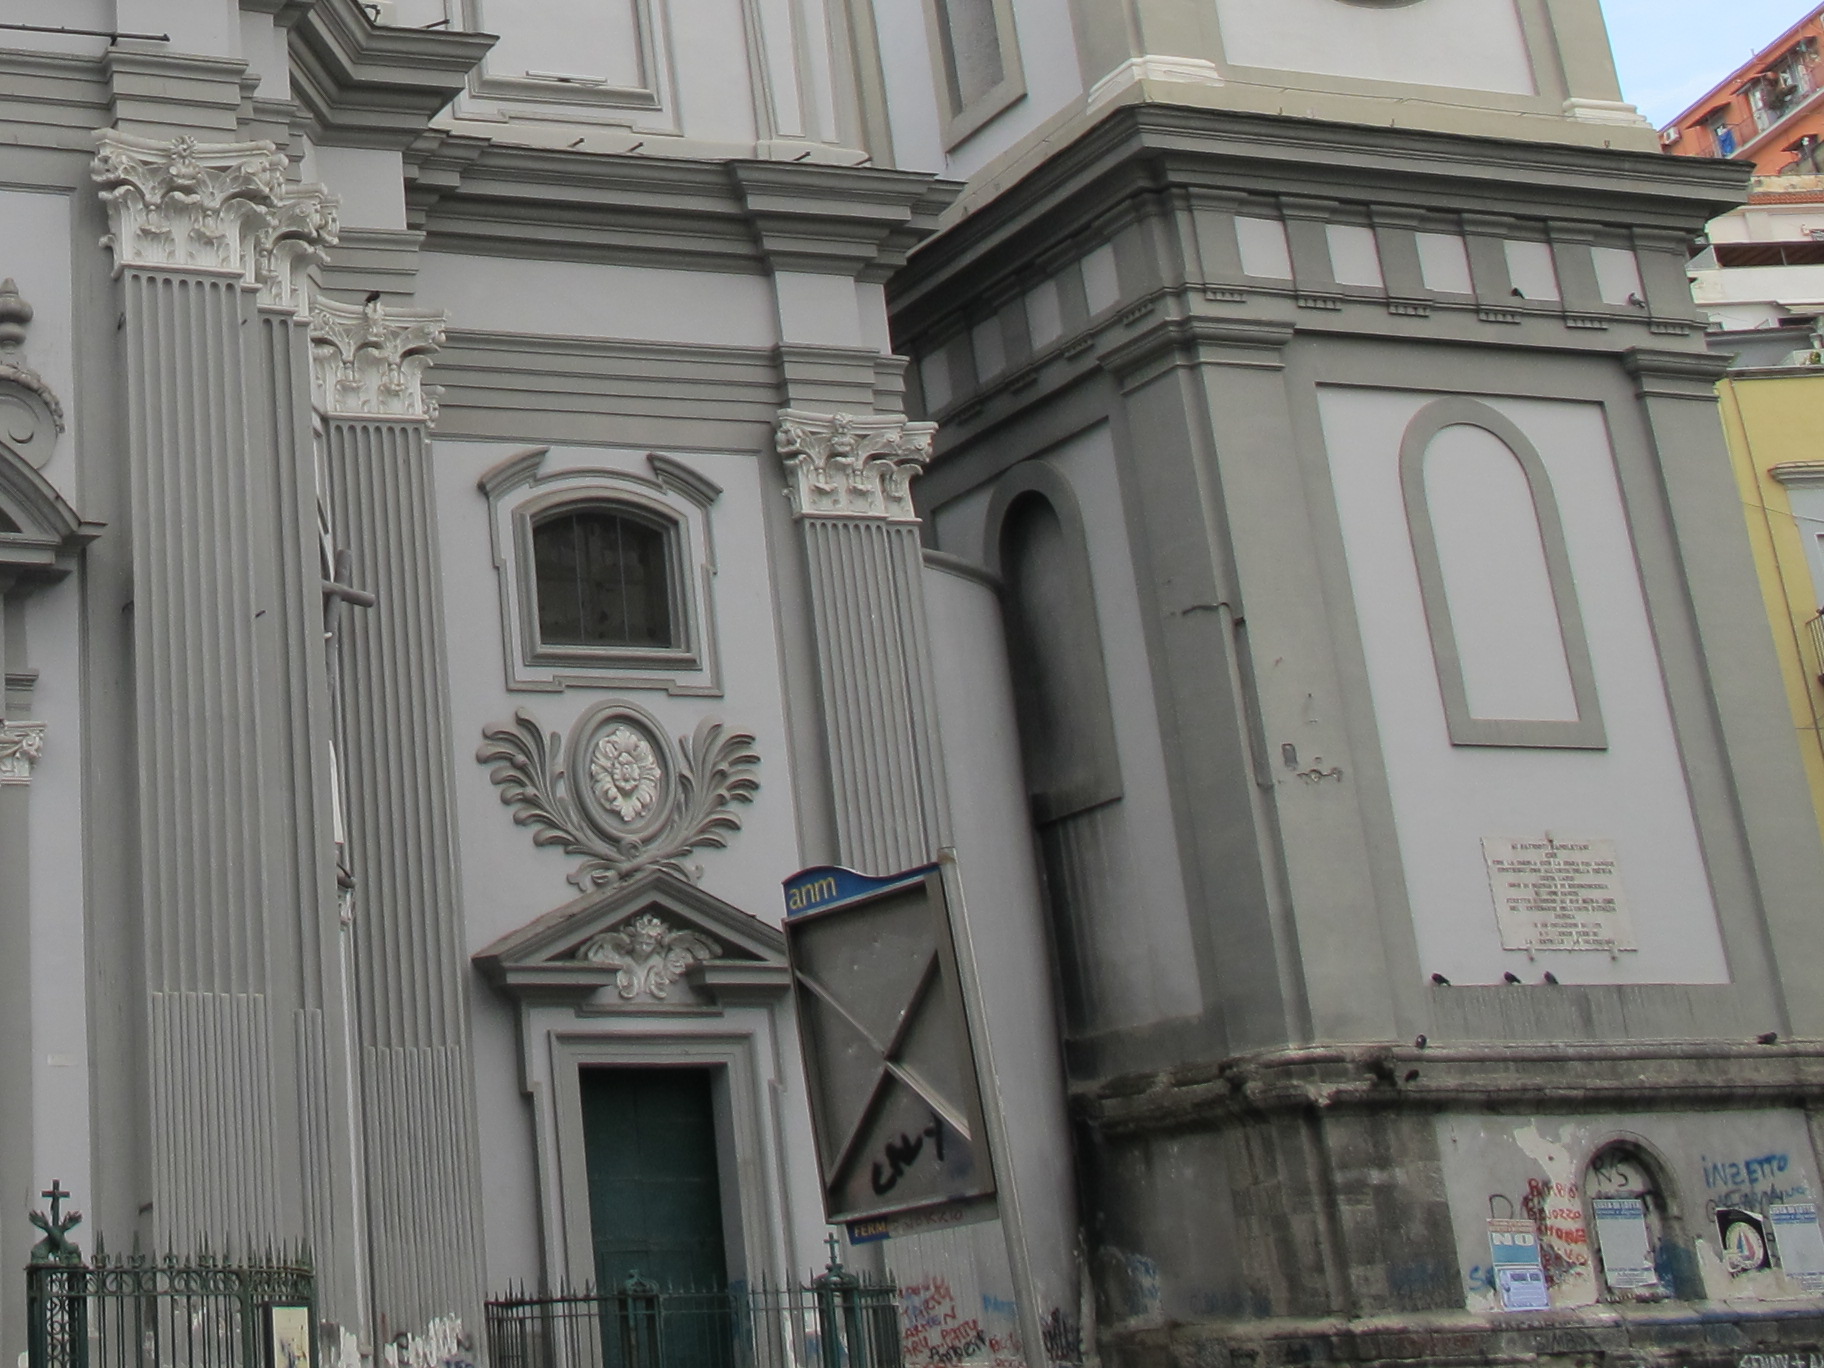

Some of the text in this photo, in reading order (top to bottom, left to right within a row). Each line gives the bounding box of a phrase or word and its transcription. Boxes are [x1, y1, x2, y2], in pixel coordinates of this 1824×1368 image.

[789, 877, 837, 910] anm
[854, 1221, 888, 1237] FERM
[1491, 1232, 1535, 1246] NO
